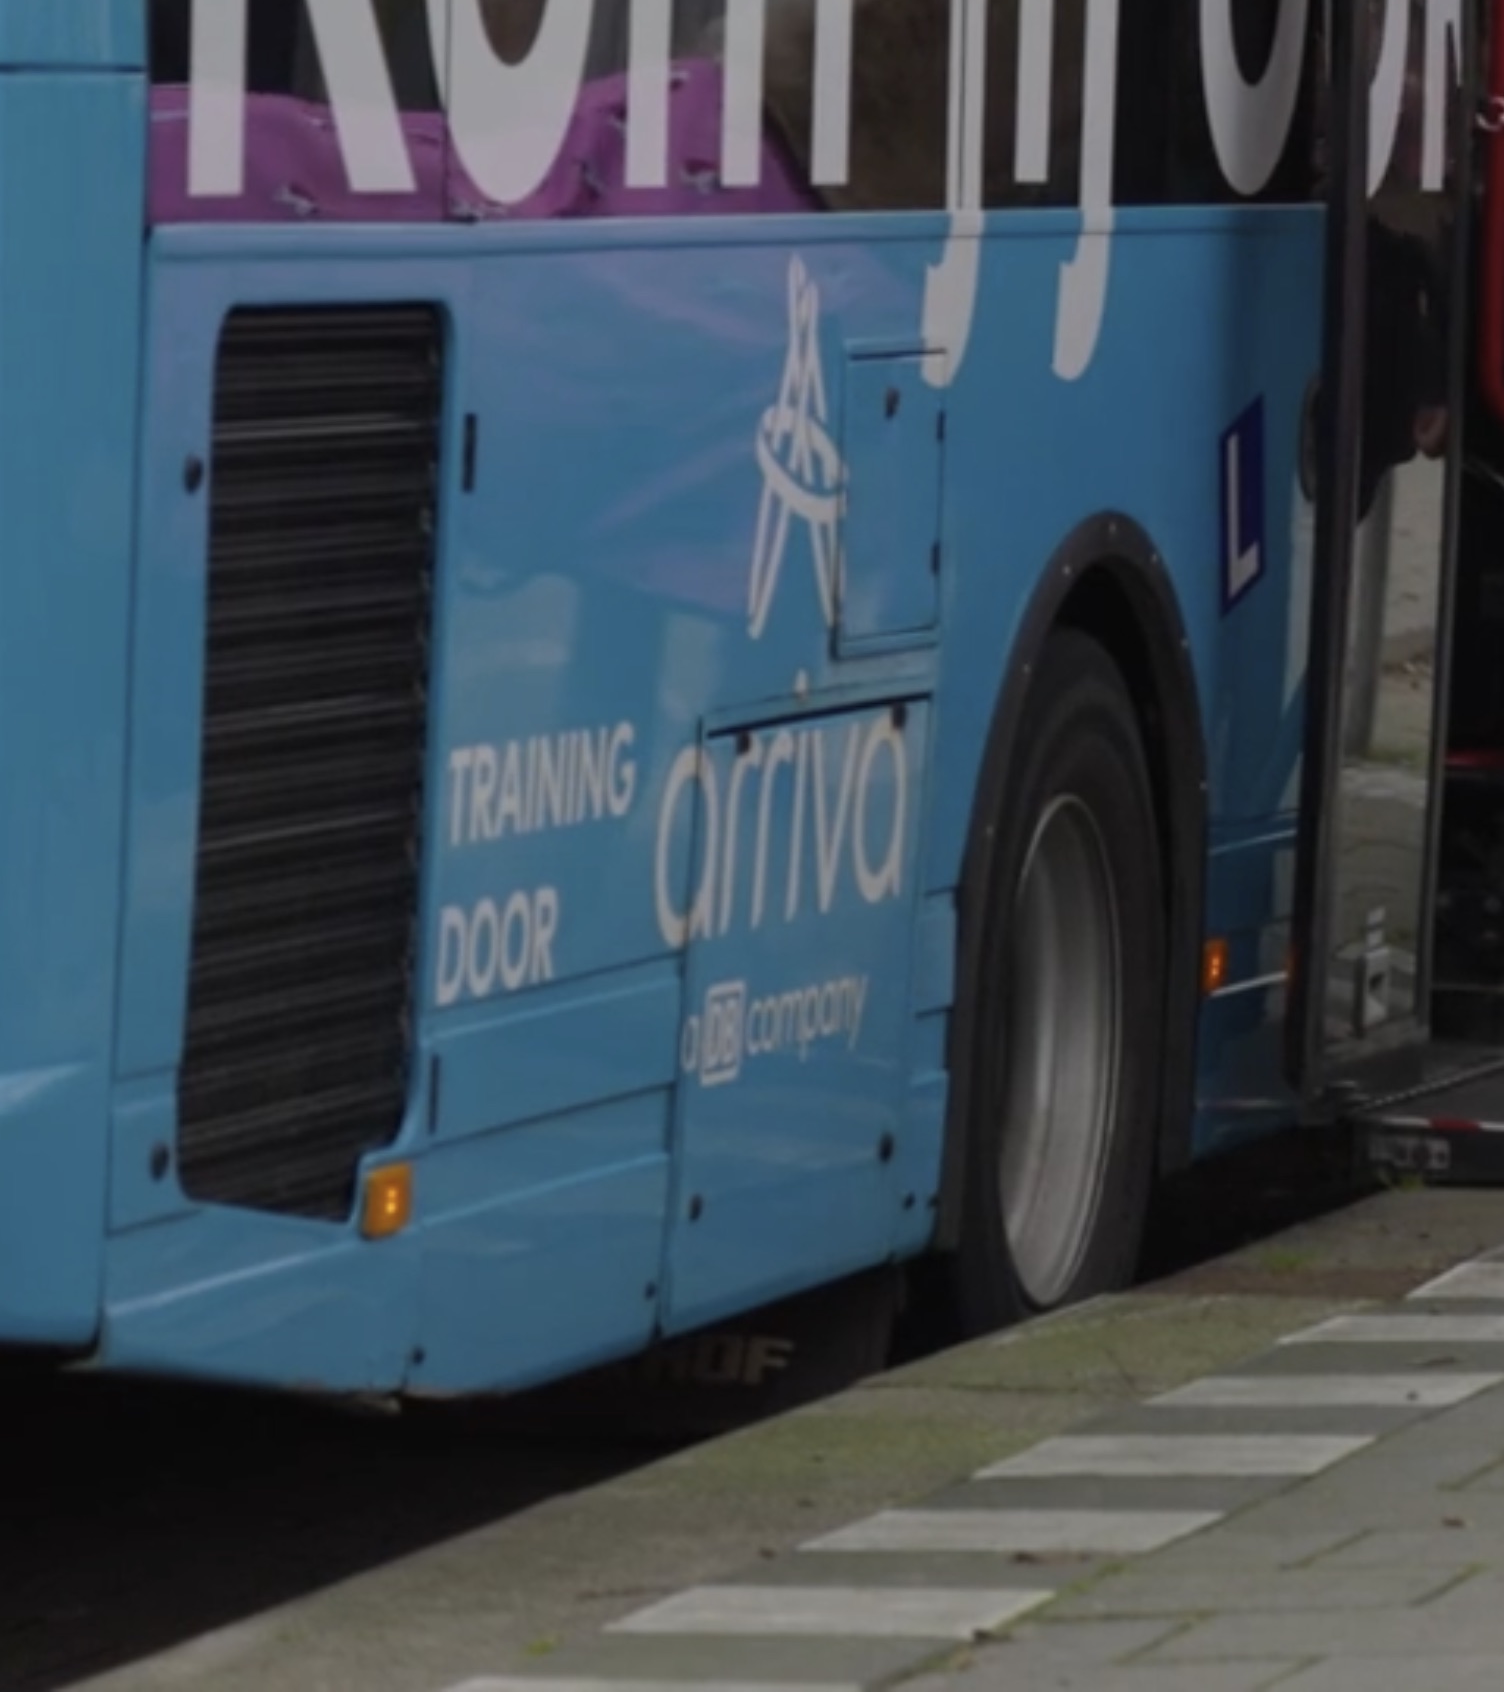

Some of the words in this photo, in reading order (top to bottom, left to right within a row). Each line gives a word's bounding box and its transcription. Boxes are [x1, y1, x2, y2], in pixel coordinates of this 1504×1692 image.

[1226, 431, 1261, 598] L
[450, 720, 636, 845] TRAINING
[654, 716, 908, 950] arriva
[435, 888, 557, 1006] DOOR
[748, 974, 870, 1064] company
